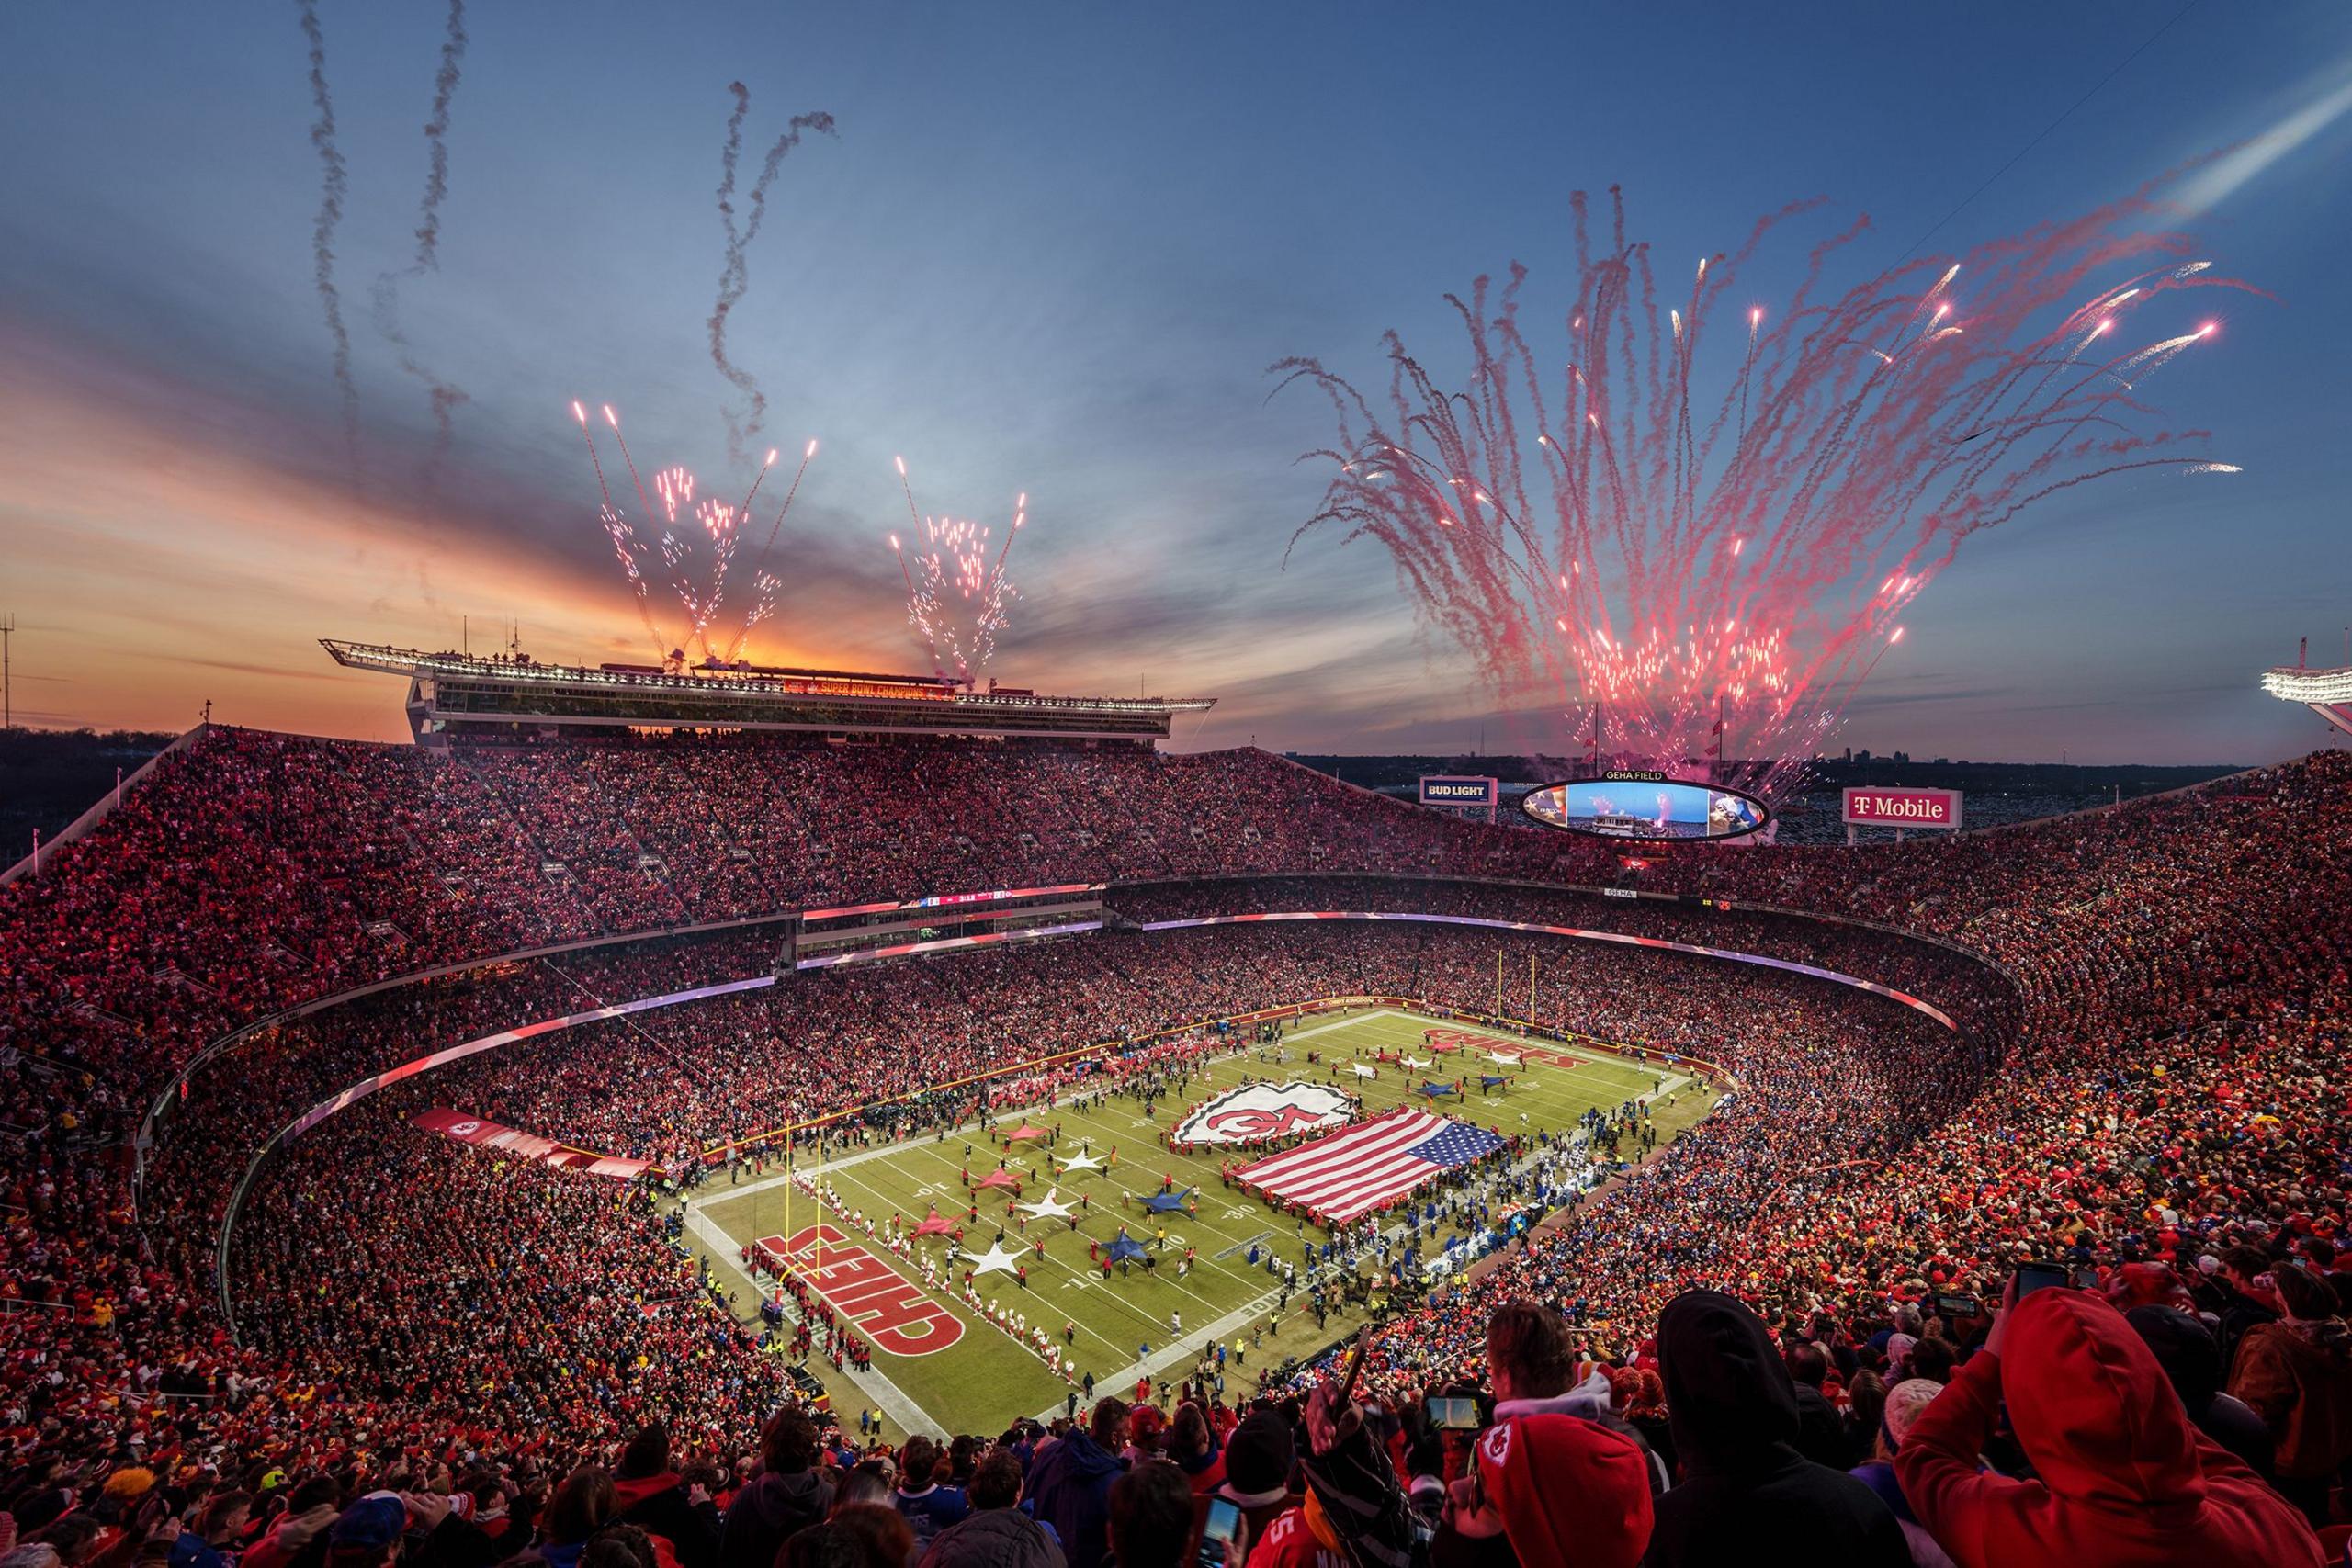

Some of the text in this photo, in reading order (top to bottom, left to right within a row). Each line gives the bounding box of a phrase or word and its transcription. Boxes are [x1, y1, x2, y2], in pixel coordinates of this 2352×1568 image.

[821, 682, 849, 693] SUPER
[852, 683, 875, 694] BOWL
[877, 685, 924, 696] CHAMPIONS
[1606, 771, 1662, 781] GEHA FIELD
[1428, 785, 1485, 796] BUD LIGHT
[1854, 796, 1943, 818] T Mobile
[1609, 888, 1633, 898] GEHA
[755, 1224, 966, 1357] CHIEFS
